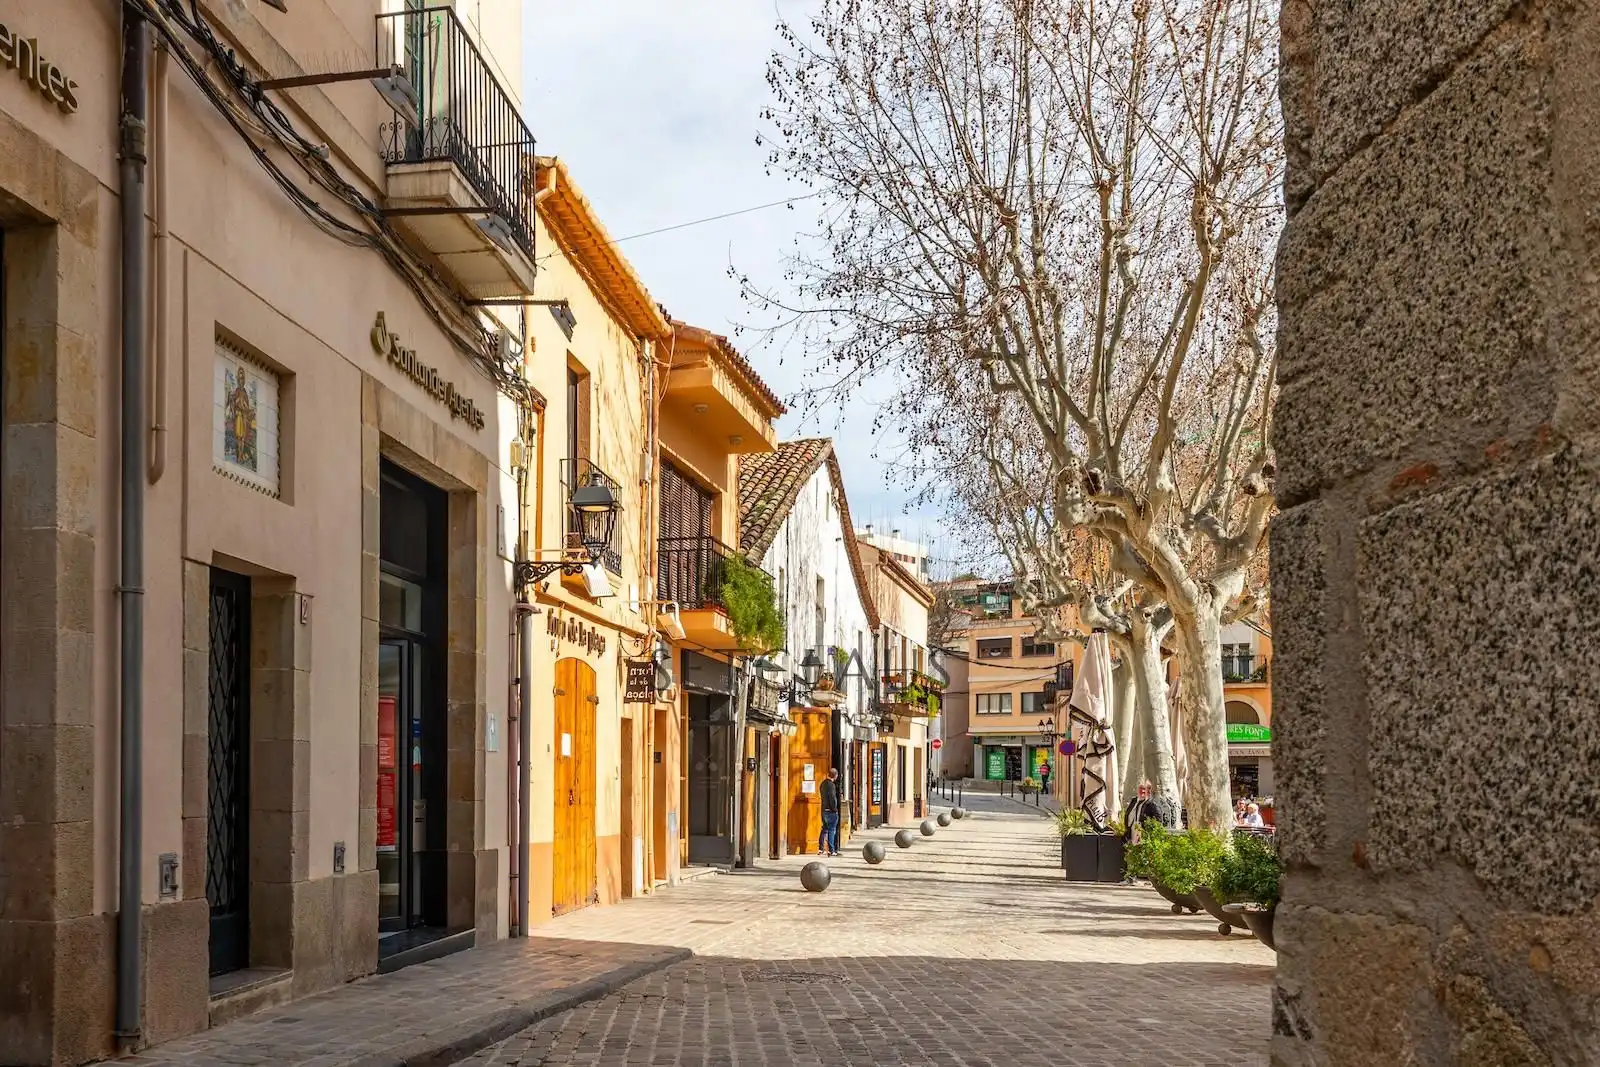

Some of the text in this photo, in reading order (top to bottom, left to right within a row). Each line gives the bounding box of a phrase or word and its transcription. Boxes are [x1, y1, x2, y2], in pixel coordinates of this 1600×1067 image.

[388, 332, 485, 431] Santander Agentes
[1244, 726, 1265, 739] FONT
